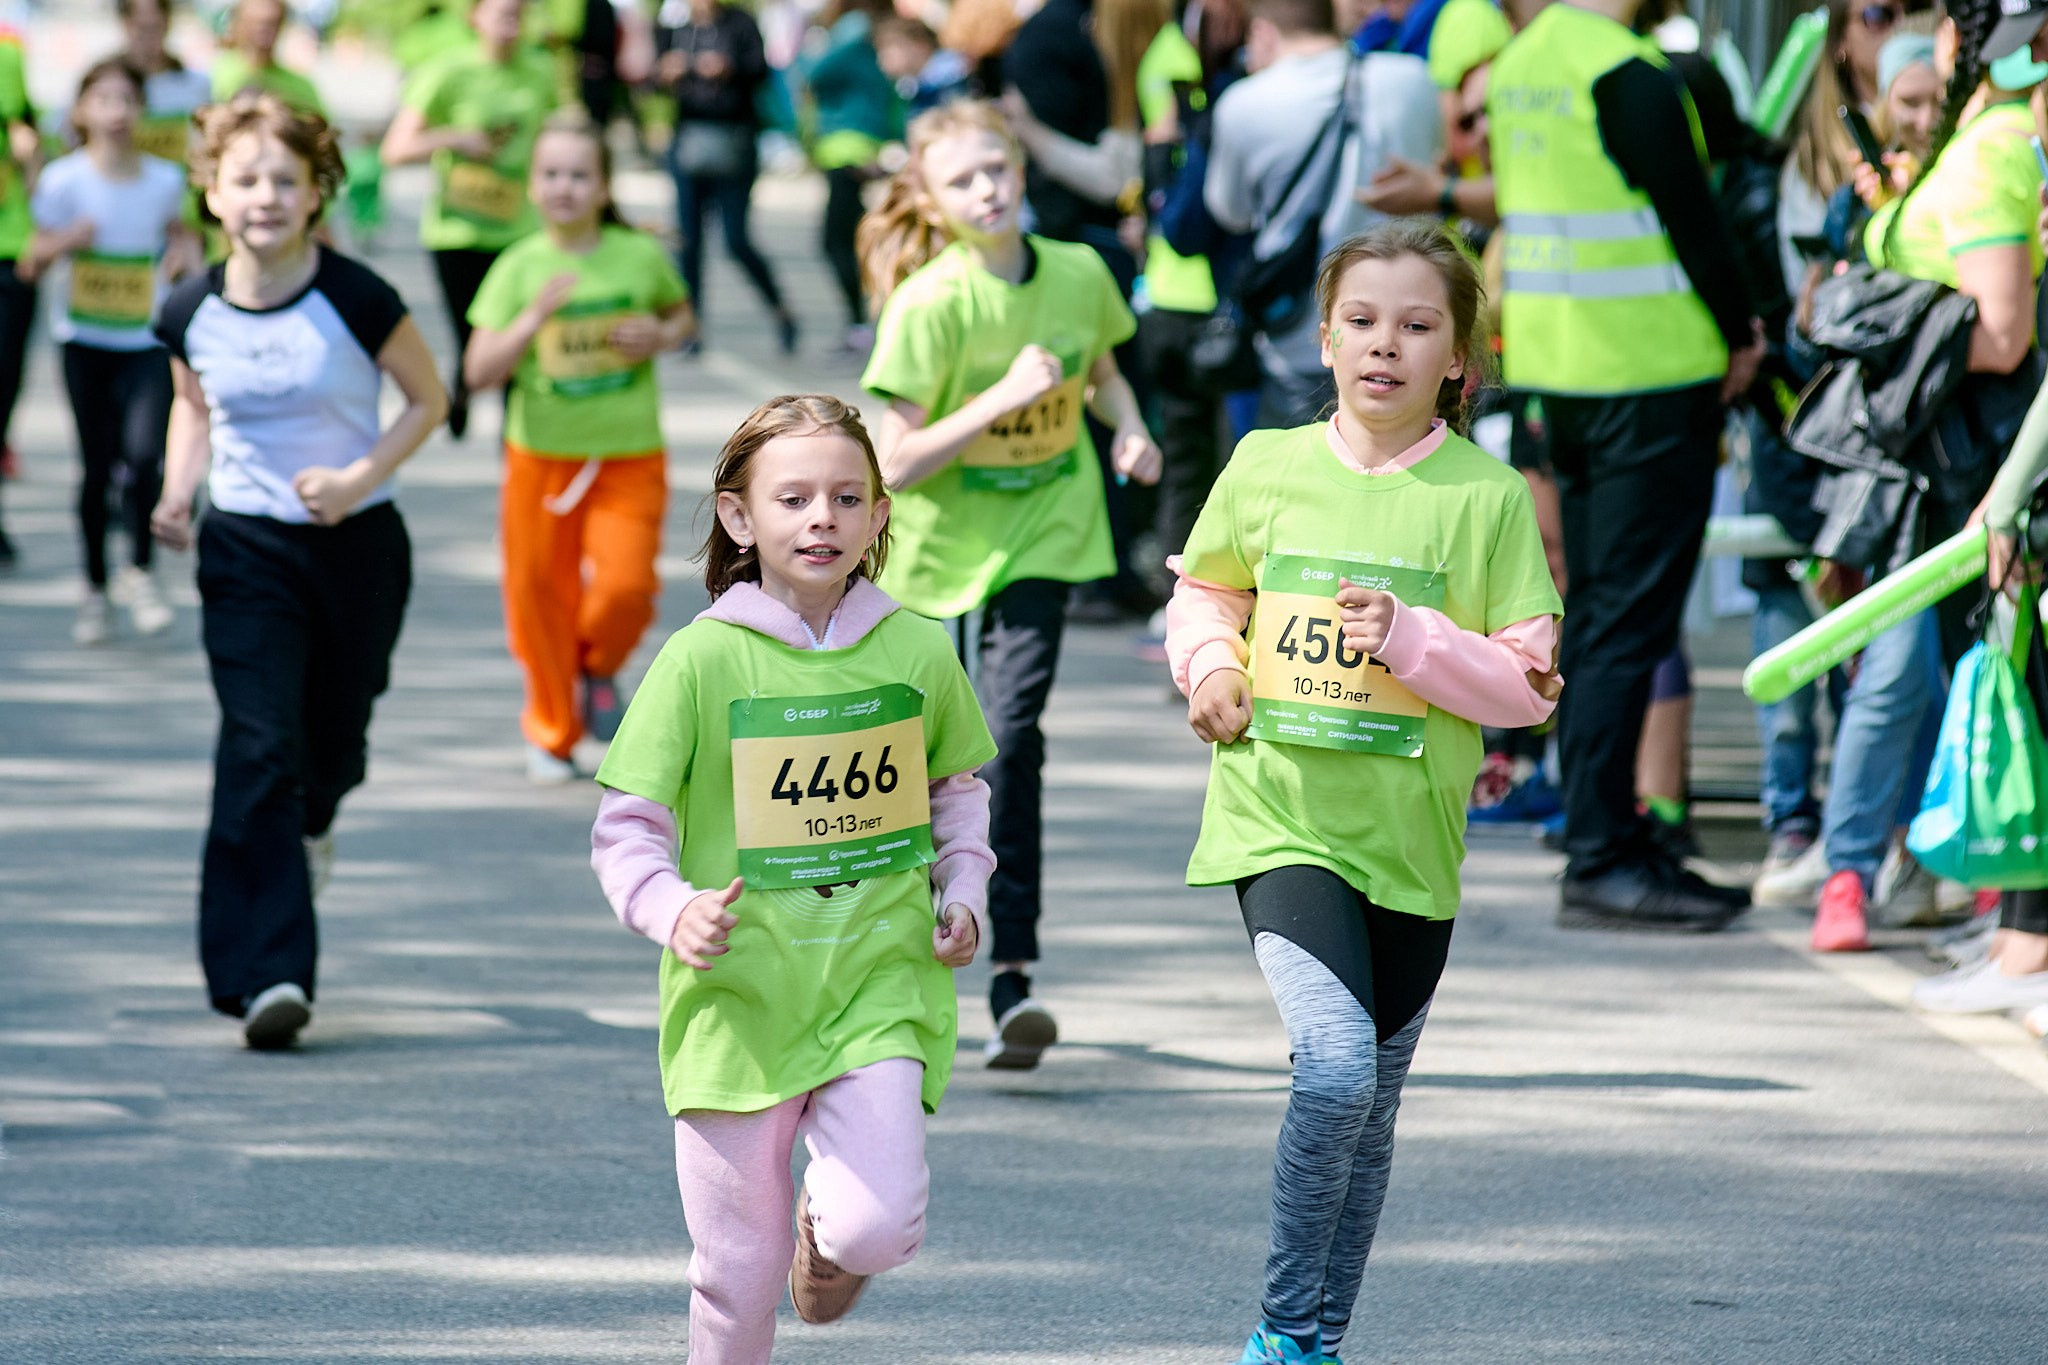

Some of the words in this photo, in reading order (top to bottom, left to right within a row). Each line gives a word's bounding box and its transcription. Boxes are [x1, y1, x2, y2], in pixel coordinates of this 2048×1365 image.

[1312, 571, 1334, 581] СБЕР
[1293, 677, 1342, 699] 10-13
[1343, 690, 1372, 703] лет
[799, 708, 829, 720] СБЕР
[1327, 730, 1374, 743] СИТИДРАЙВ
[771, 745, 898, 806] 4466
[805, 815, 857, 837] 10-13
[858, 816, 883, 831] лет
